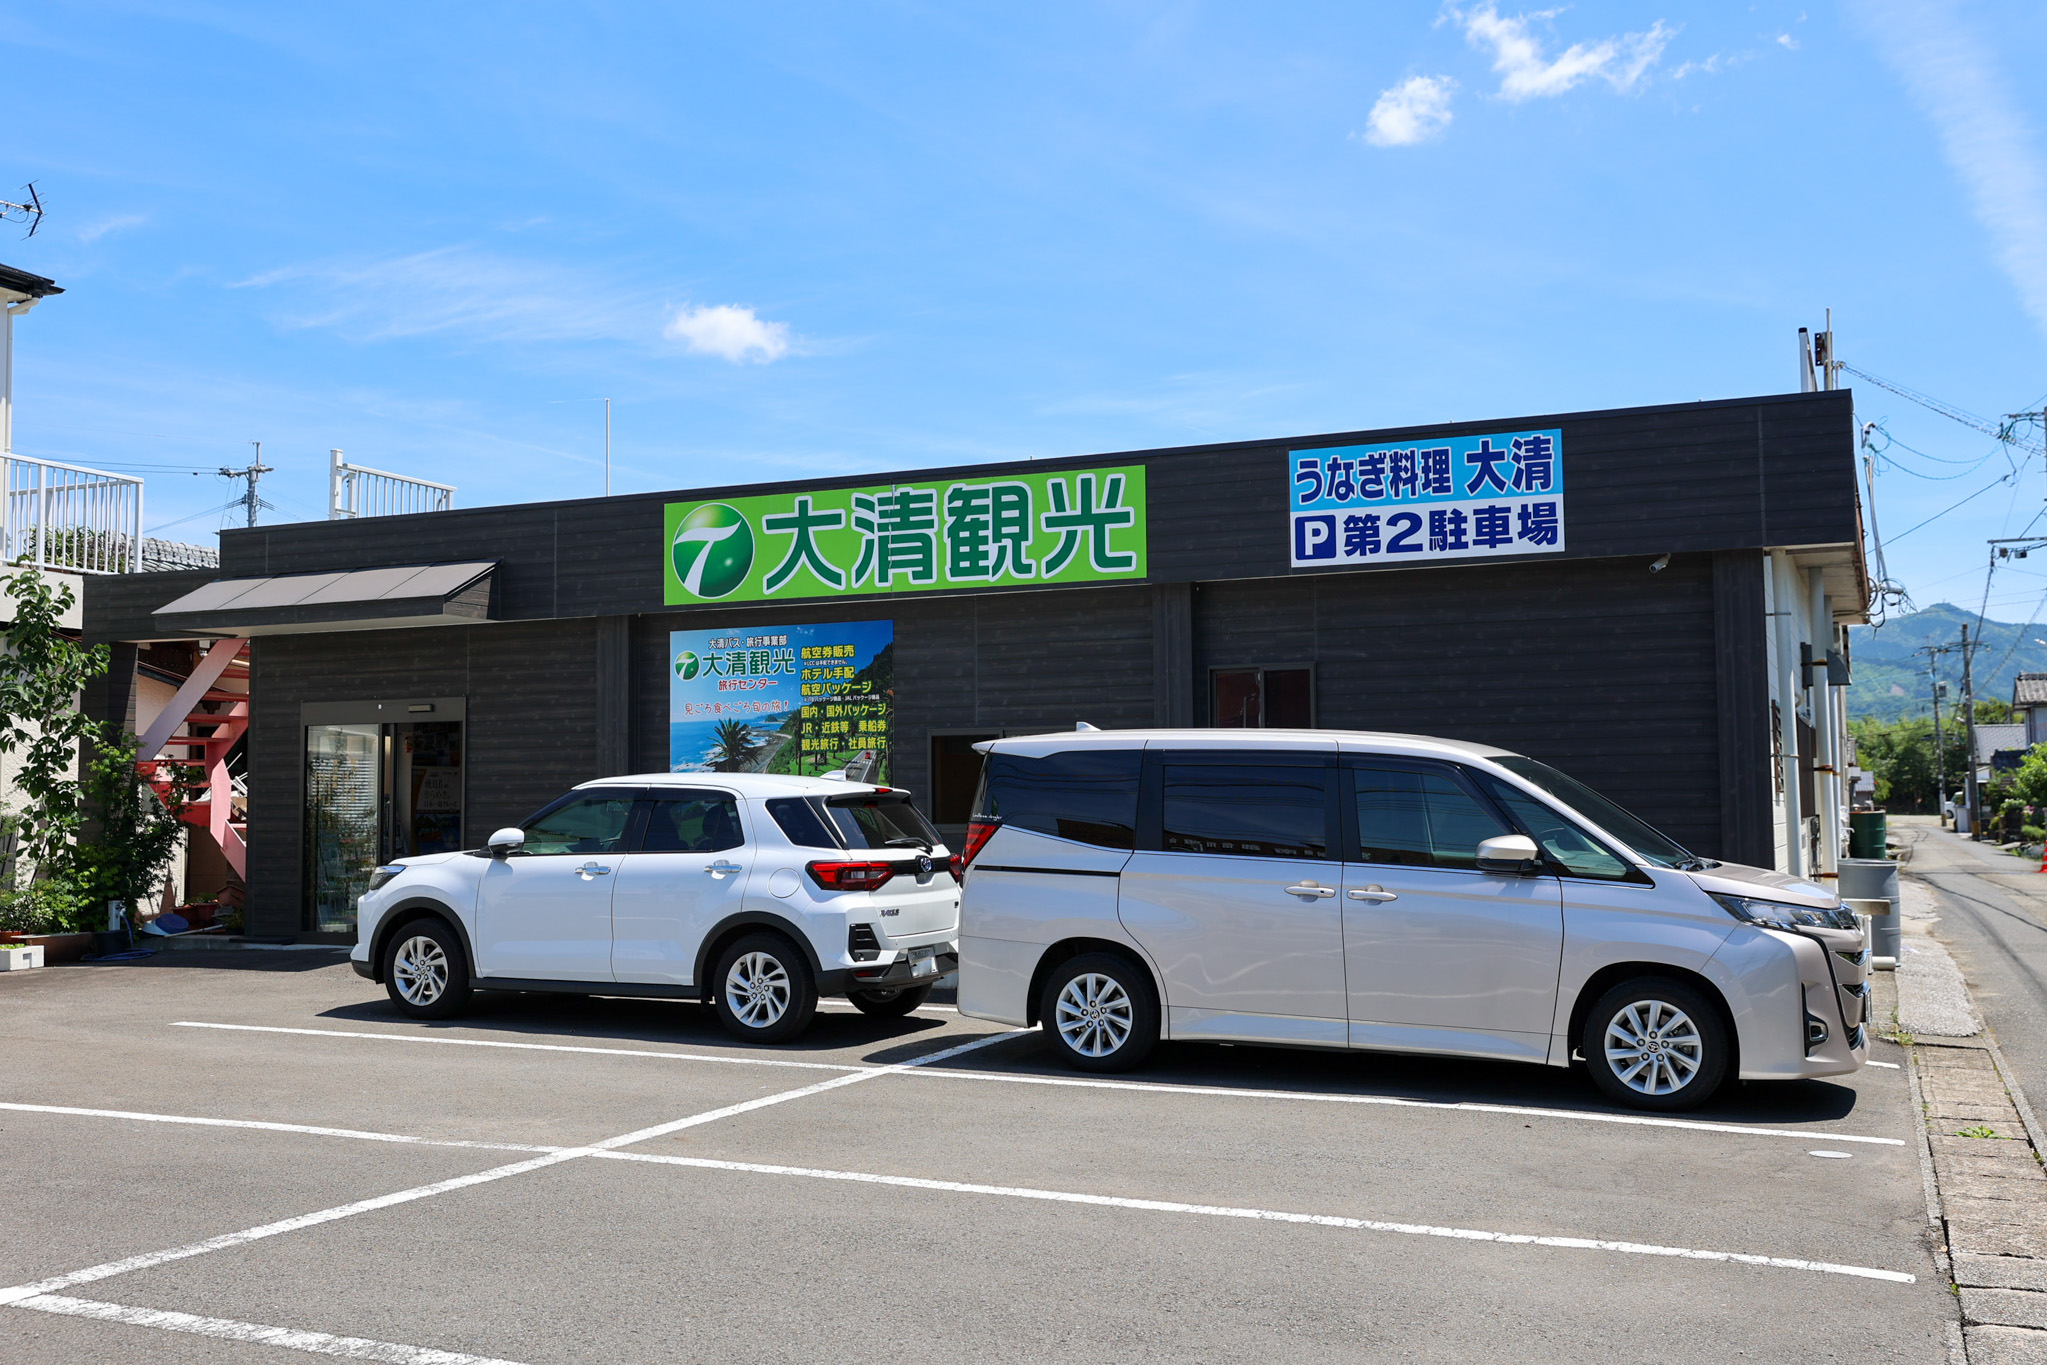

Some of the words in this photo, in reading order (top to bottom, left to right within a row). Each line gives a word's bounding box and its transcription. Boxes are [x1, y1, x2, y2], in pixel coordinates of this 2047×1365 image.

[1295, 447, 1453, 505] うなぎ料理
[1465, 434, 1554, 496] 大清
[762, 473, 1137, 595] 大清観光
[1343, 501, 1559, 557] 第2駐車場
[708, 635, 788, 650] 大清バス・旅行事業部
[801, 645, 855, 659] 航空券販売
[702, 648, 796, 678] 大清観光
[801, 666, 855, 680] ホテル手配
[718, 678, 778, 692] 旅行センター
[801, 681, 872, 695] 航空パッケージ
[858, 720, 886, 732] 乗船券
[801, 736, 886, 751] 観光旅行・社員旅行
